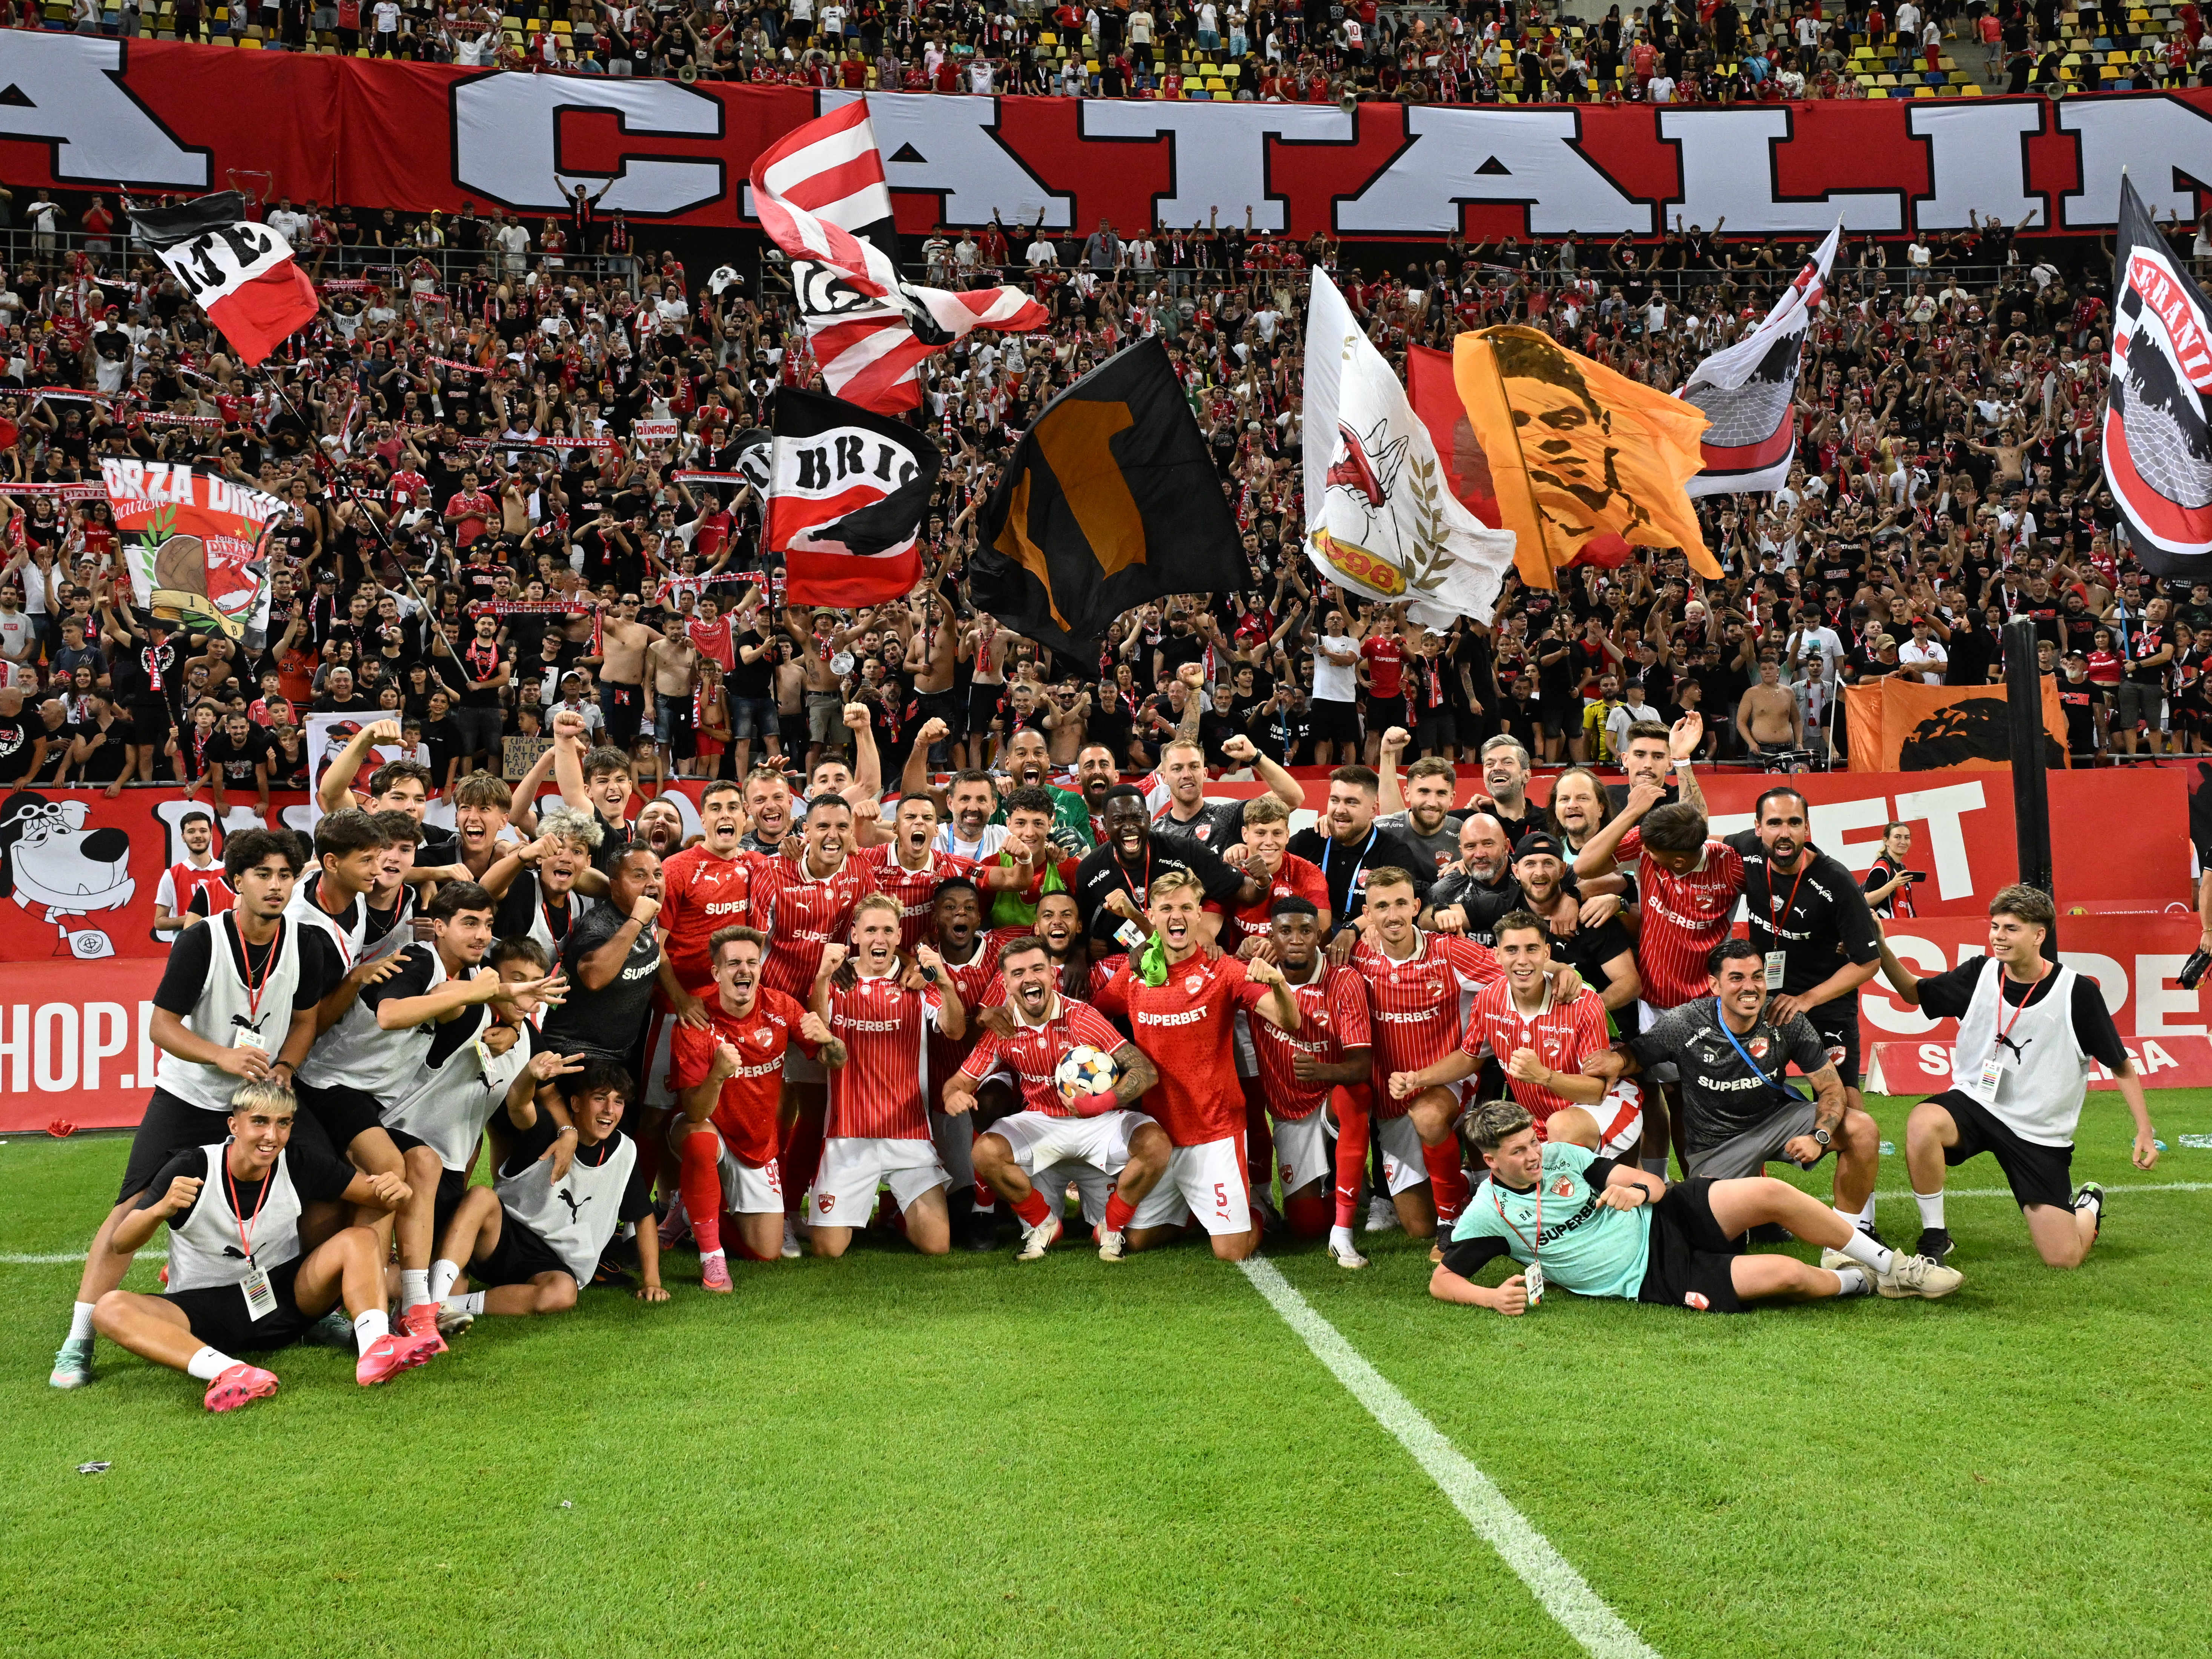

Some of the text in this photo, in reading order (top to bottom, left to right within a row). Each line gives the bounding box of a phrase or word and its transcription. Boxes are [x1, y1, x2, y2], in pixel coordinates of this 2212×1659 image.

[1349, 25, 1358, 37] 10
[283, 663, 294, 672] 25
[1271, 732, 1285, 741] 199
[900, 901, 937, 918] ERBET
[1648, 895, 1714, 930] SUPERBET
[1233, 917, 1272, 934] SUPER
[622, 955, 661, 981] SUPERB
[1138, 1005, 1207, 1027] SUPERBET
[0, 1002, 158, 1093] HOP.
[1704, 1054, 1714, 1063] SP
[1019, 1071, 1057, 1086] SUPER
[1214, 1183, 1227, 1207] 5
[1539, 1189, 1599, 1246] SUPERBET
